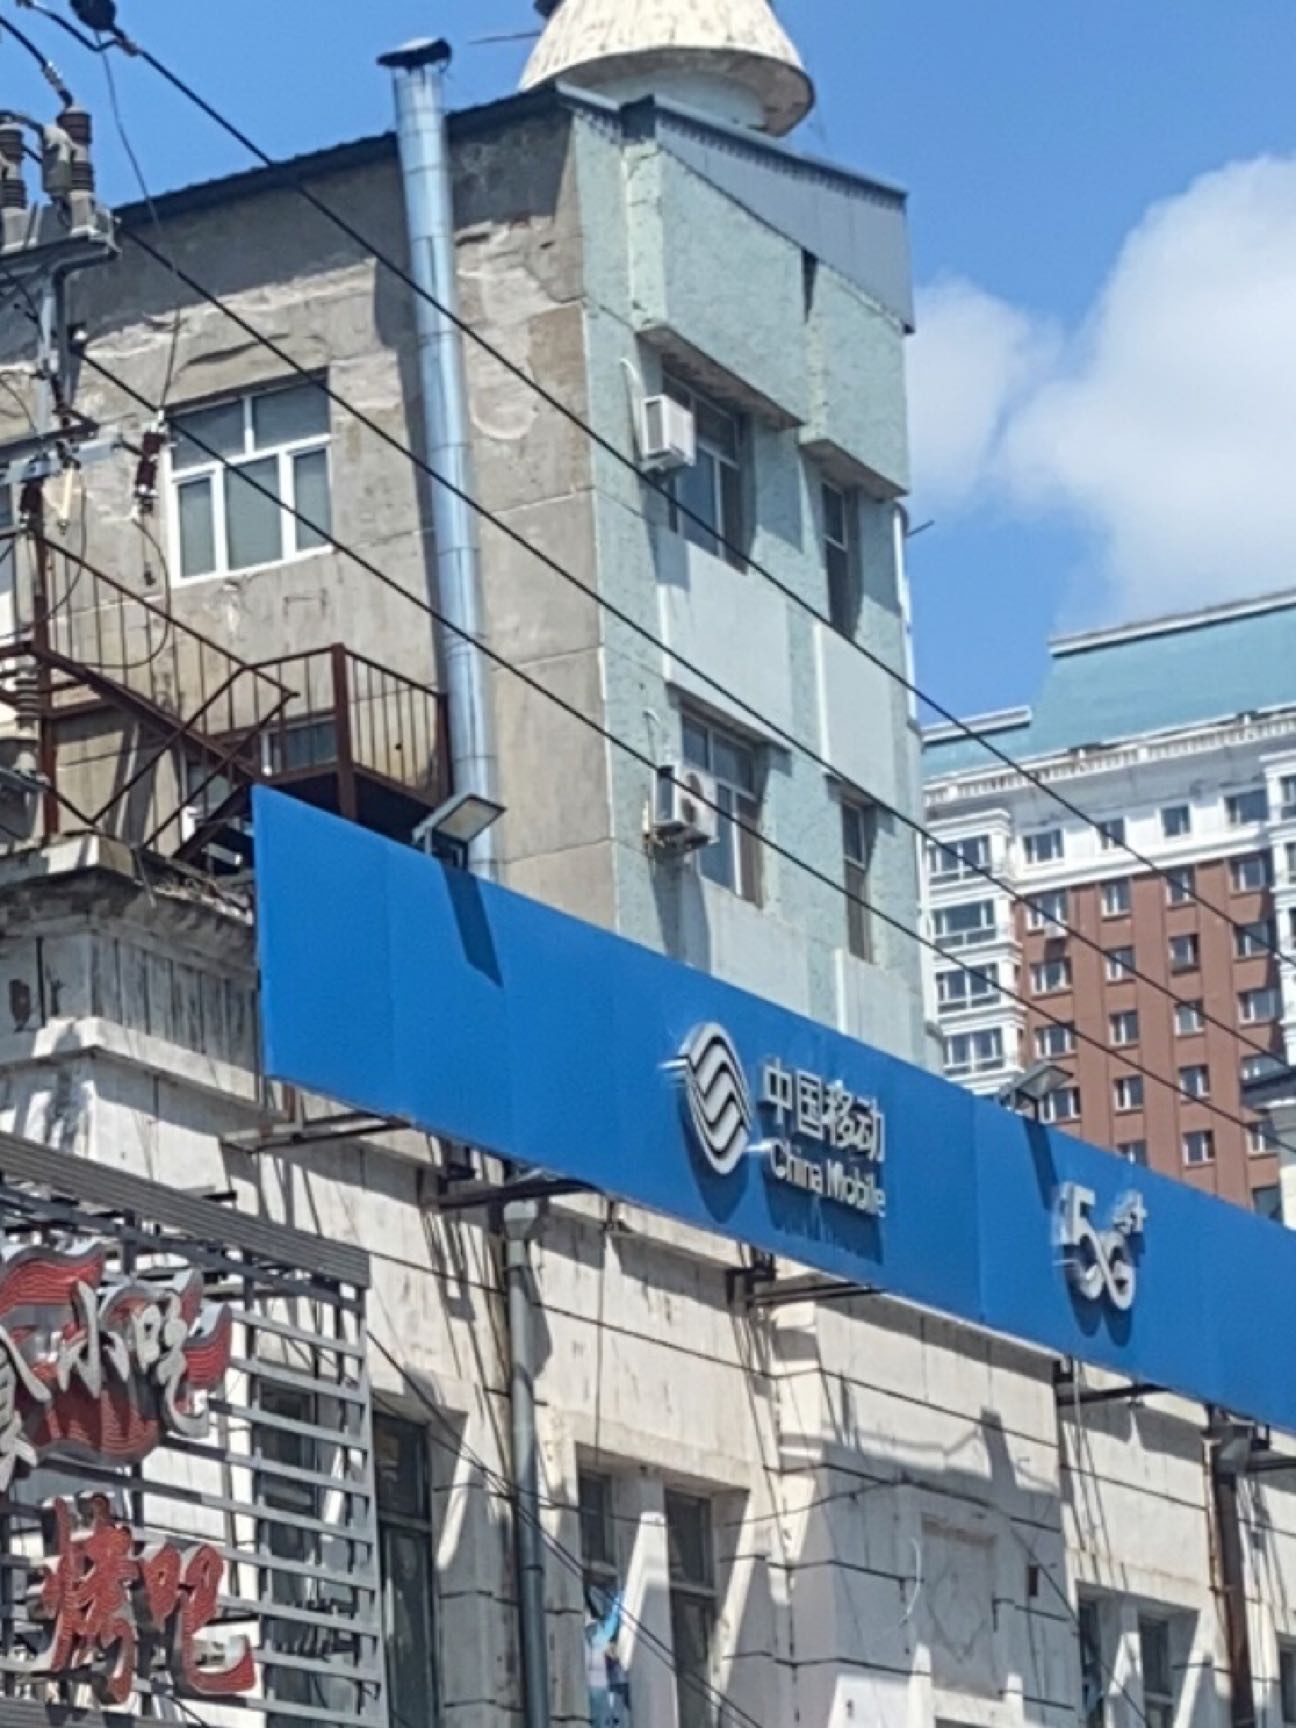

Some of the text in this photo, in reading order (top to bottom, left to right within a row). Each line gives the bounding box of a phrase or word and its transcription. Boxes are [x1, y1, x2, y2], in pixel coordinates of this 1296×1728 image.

[764, 1057, 885, 1162] 中国移动
[770, 1138, 886, 1218] China Mobile
